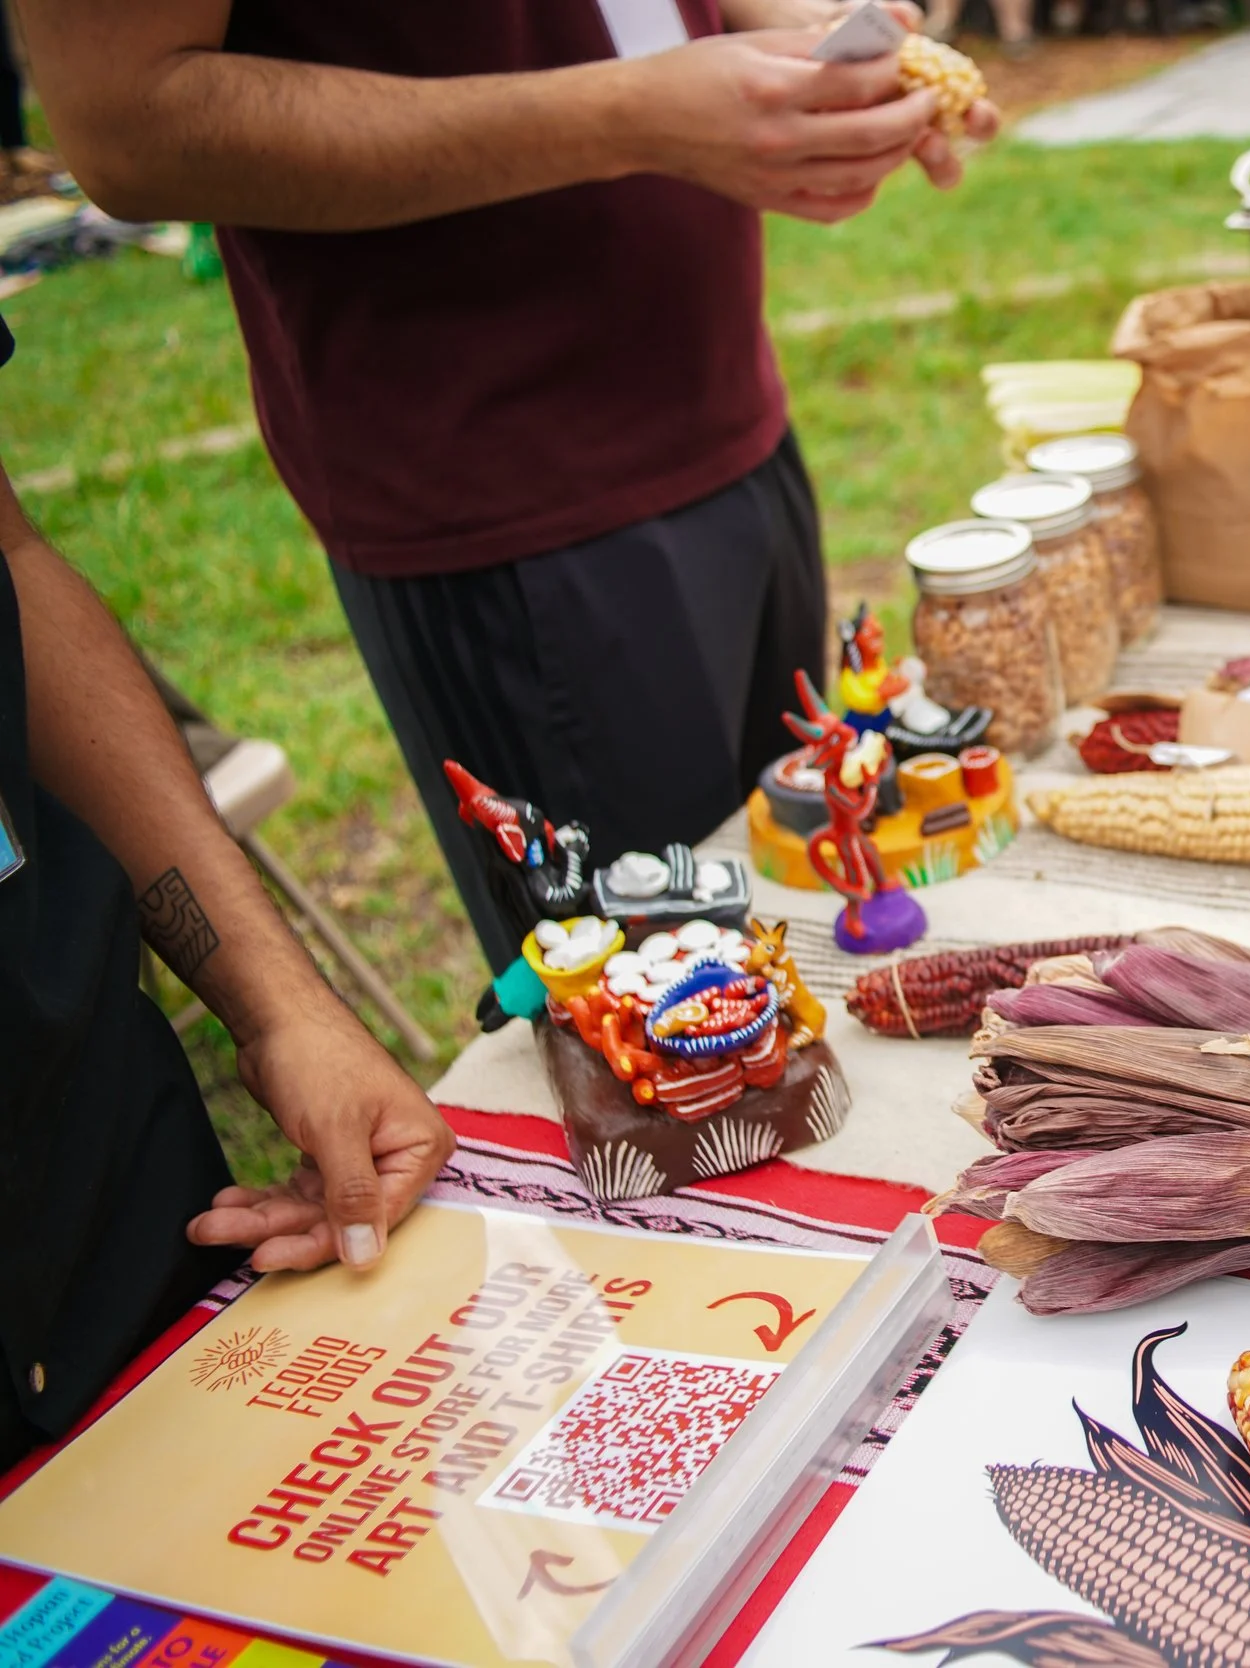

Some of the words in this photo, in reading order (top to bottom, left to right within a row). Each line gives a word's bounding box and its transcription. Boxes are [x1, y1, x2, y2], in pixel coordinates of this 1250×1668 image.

[227, 1411, 405, 1551] CHECK
[371, 1333, 476, 1408] OUT
[449, 1261, 554, 1331] OUR
[245, 1336, 351, 1409] TEQUIO
[285, 1344, 387, 1417] FOODS
[293, 1464, 412, 1564] ONLINE
[391, 1382, 491, 1463] STORE
[468, 1335, 538, 1381] FOR
[514, 1268, 600, 1333] MORE
[345, 1496, 444, 1578] ART
[421, 1420, 519, 1496] AND
[489, 1277, 653, 1411] T-SHIRTS
